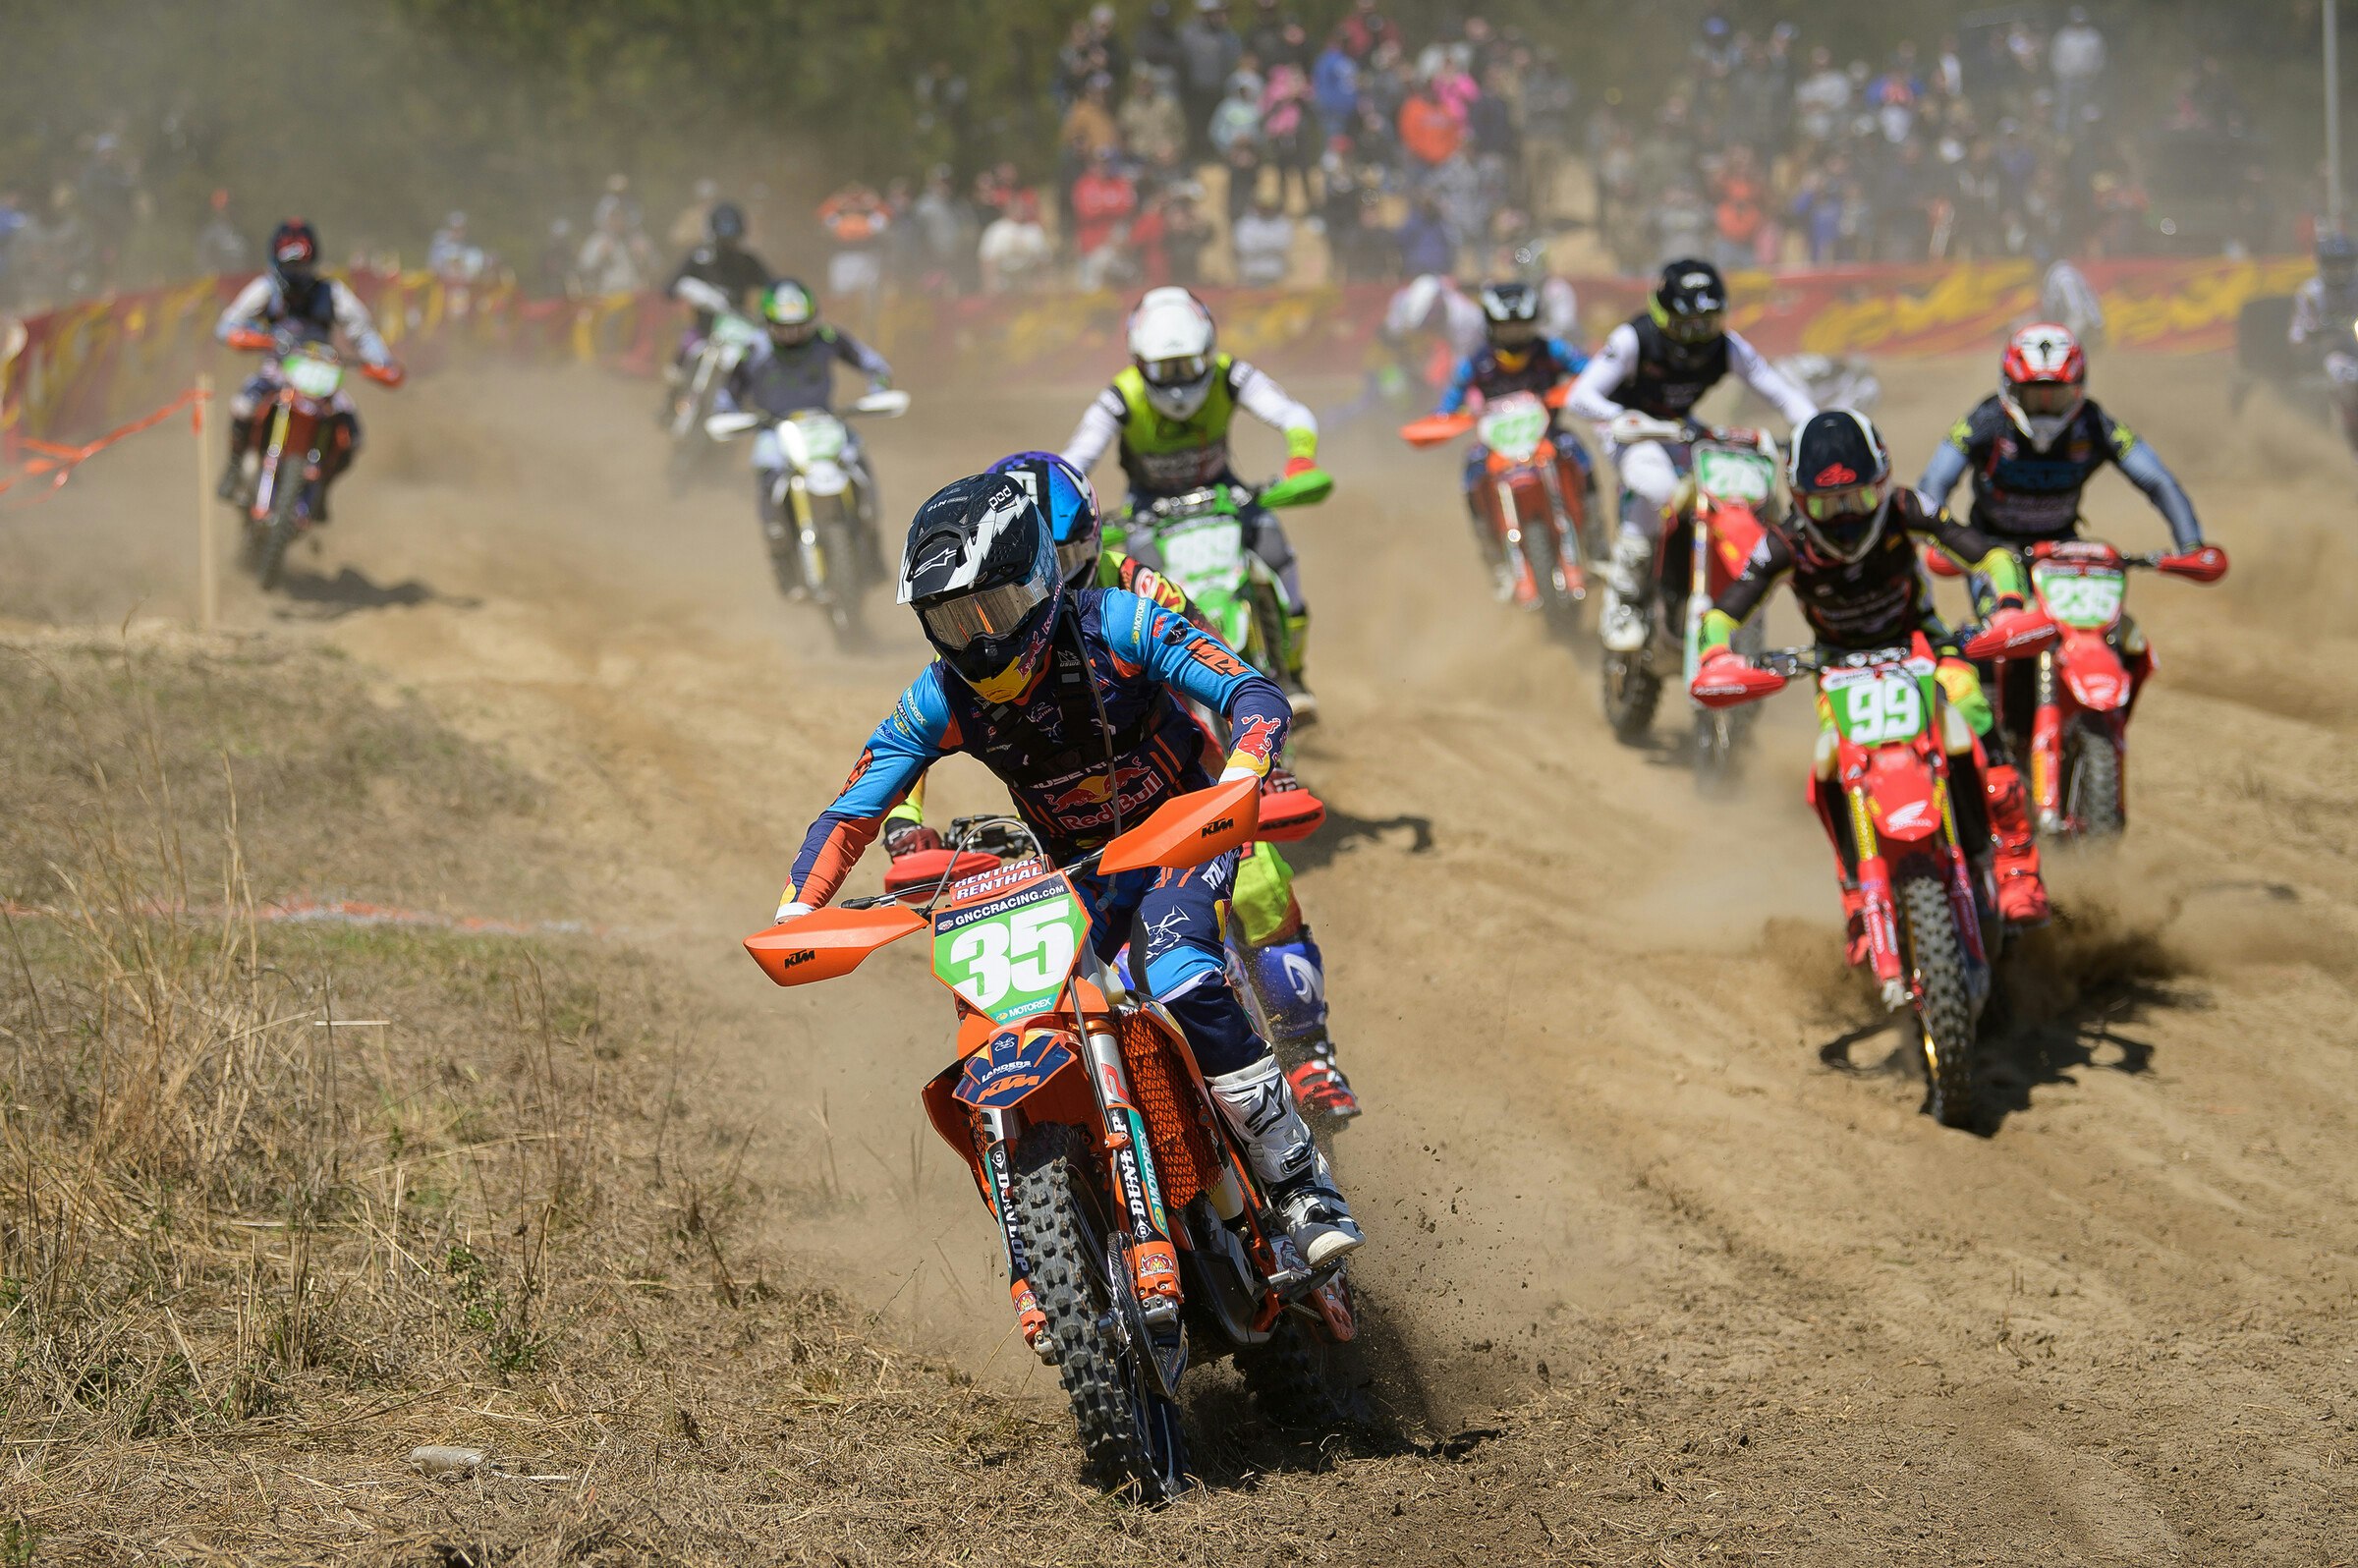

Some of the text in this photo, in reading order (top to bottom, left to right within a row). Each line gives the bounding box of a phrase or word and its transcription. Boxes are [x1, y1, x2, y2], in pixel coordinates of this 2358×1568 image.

[987, 485, 1012, 511] pod
[2046, 577, 2122, 621] 235
[1846, 677, 1921, 745] 99
[1057, 770, 1164, 830] Red Bull
[1201, 817, 1234, 838] KTM
[956, 867, 1043, 901] RENTHAL
[784, 949, 815, 970] KTM
[950, 898, 1075, 1011] 35
[1008, 997, 1051, 1018] MOTOREX
[982, 1060, 1032, 1084] LANDERS
[976, 1074, 1041, 1104] KTM
[1137, 1127, 1162, 1207] MOTOREX
